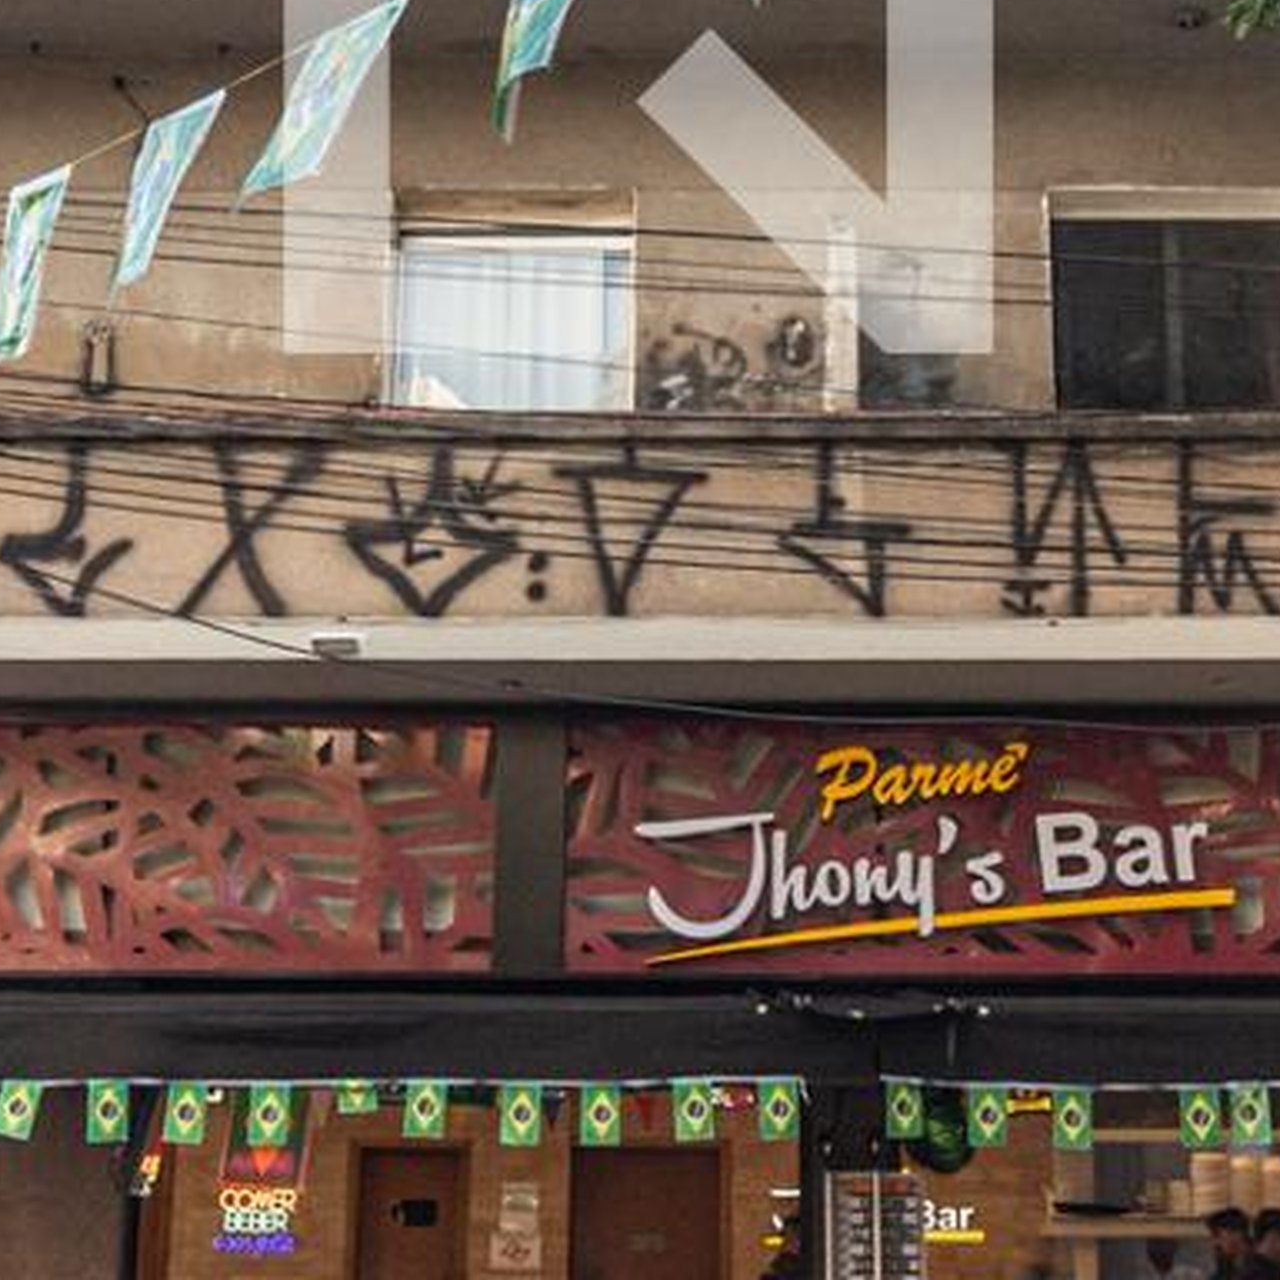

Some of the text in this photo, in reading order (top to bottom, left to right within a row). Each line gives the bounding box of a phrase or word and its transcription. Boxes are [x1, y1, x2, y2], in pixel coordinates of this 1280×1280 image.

[635, 812, 1209, 940] Jhony's Bar
[219, 1188, 297, 1212] COMER
[223, 1210, 288, 1233] BEBER
[922, 1200, 974, 1230] Bar
